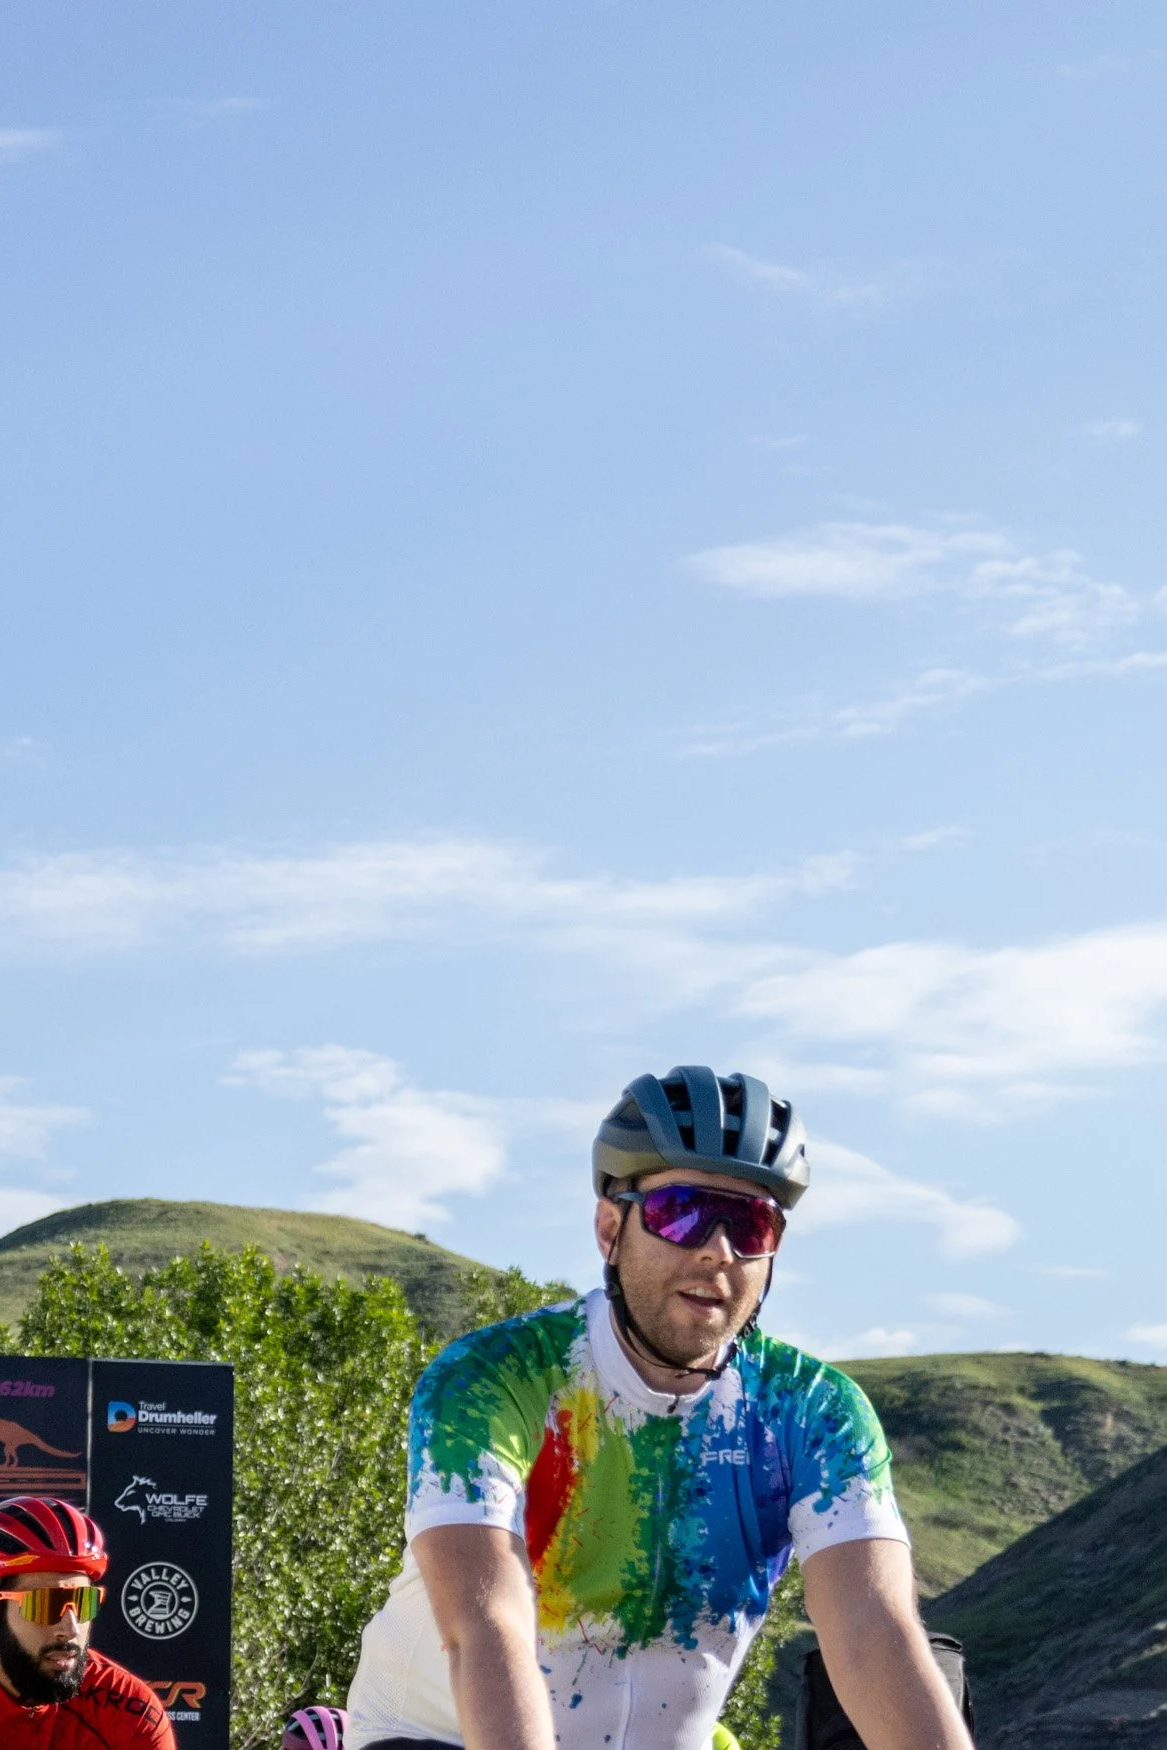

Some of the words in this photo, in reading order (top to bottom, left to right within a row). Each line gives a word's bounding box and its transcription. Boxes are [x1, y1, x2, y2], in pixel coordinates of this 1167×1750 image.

[138, 1401, 166, 1411] Travel
[138, 1410, 217, 1425] Drumheller
[145, 1494, 208, 1506] WOLFE
[131, 1568, 189, 1591] VALLEY
[128, 1608, 190, 1634] BREWING
[176, 1711, 200, 1721] CENTER
